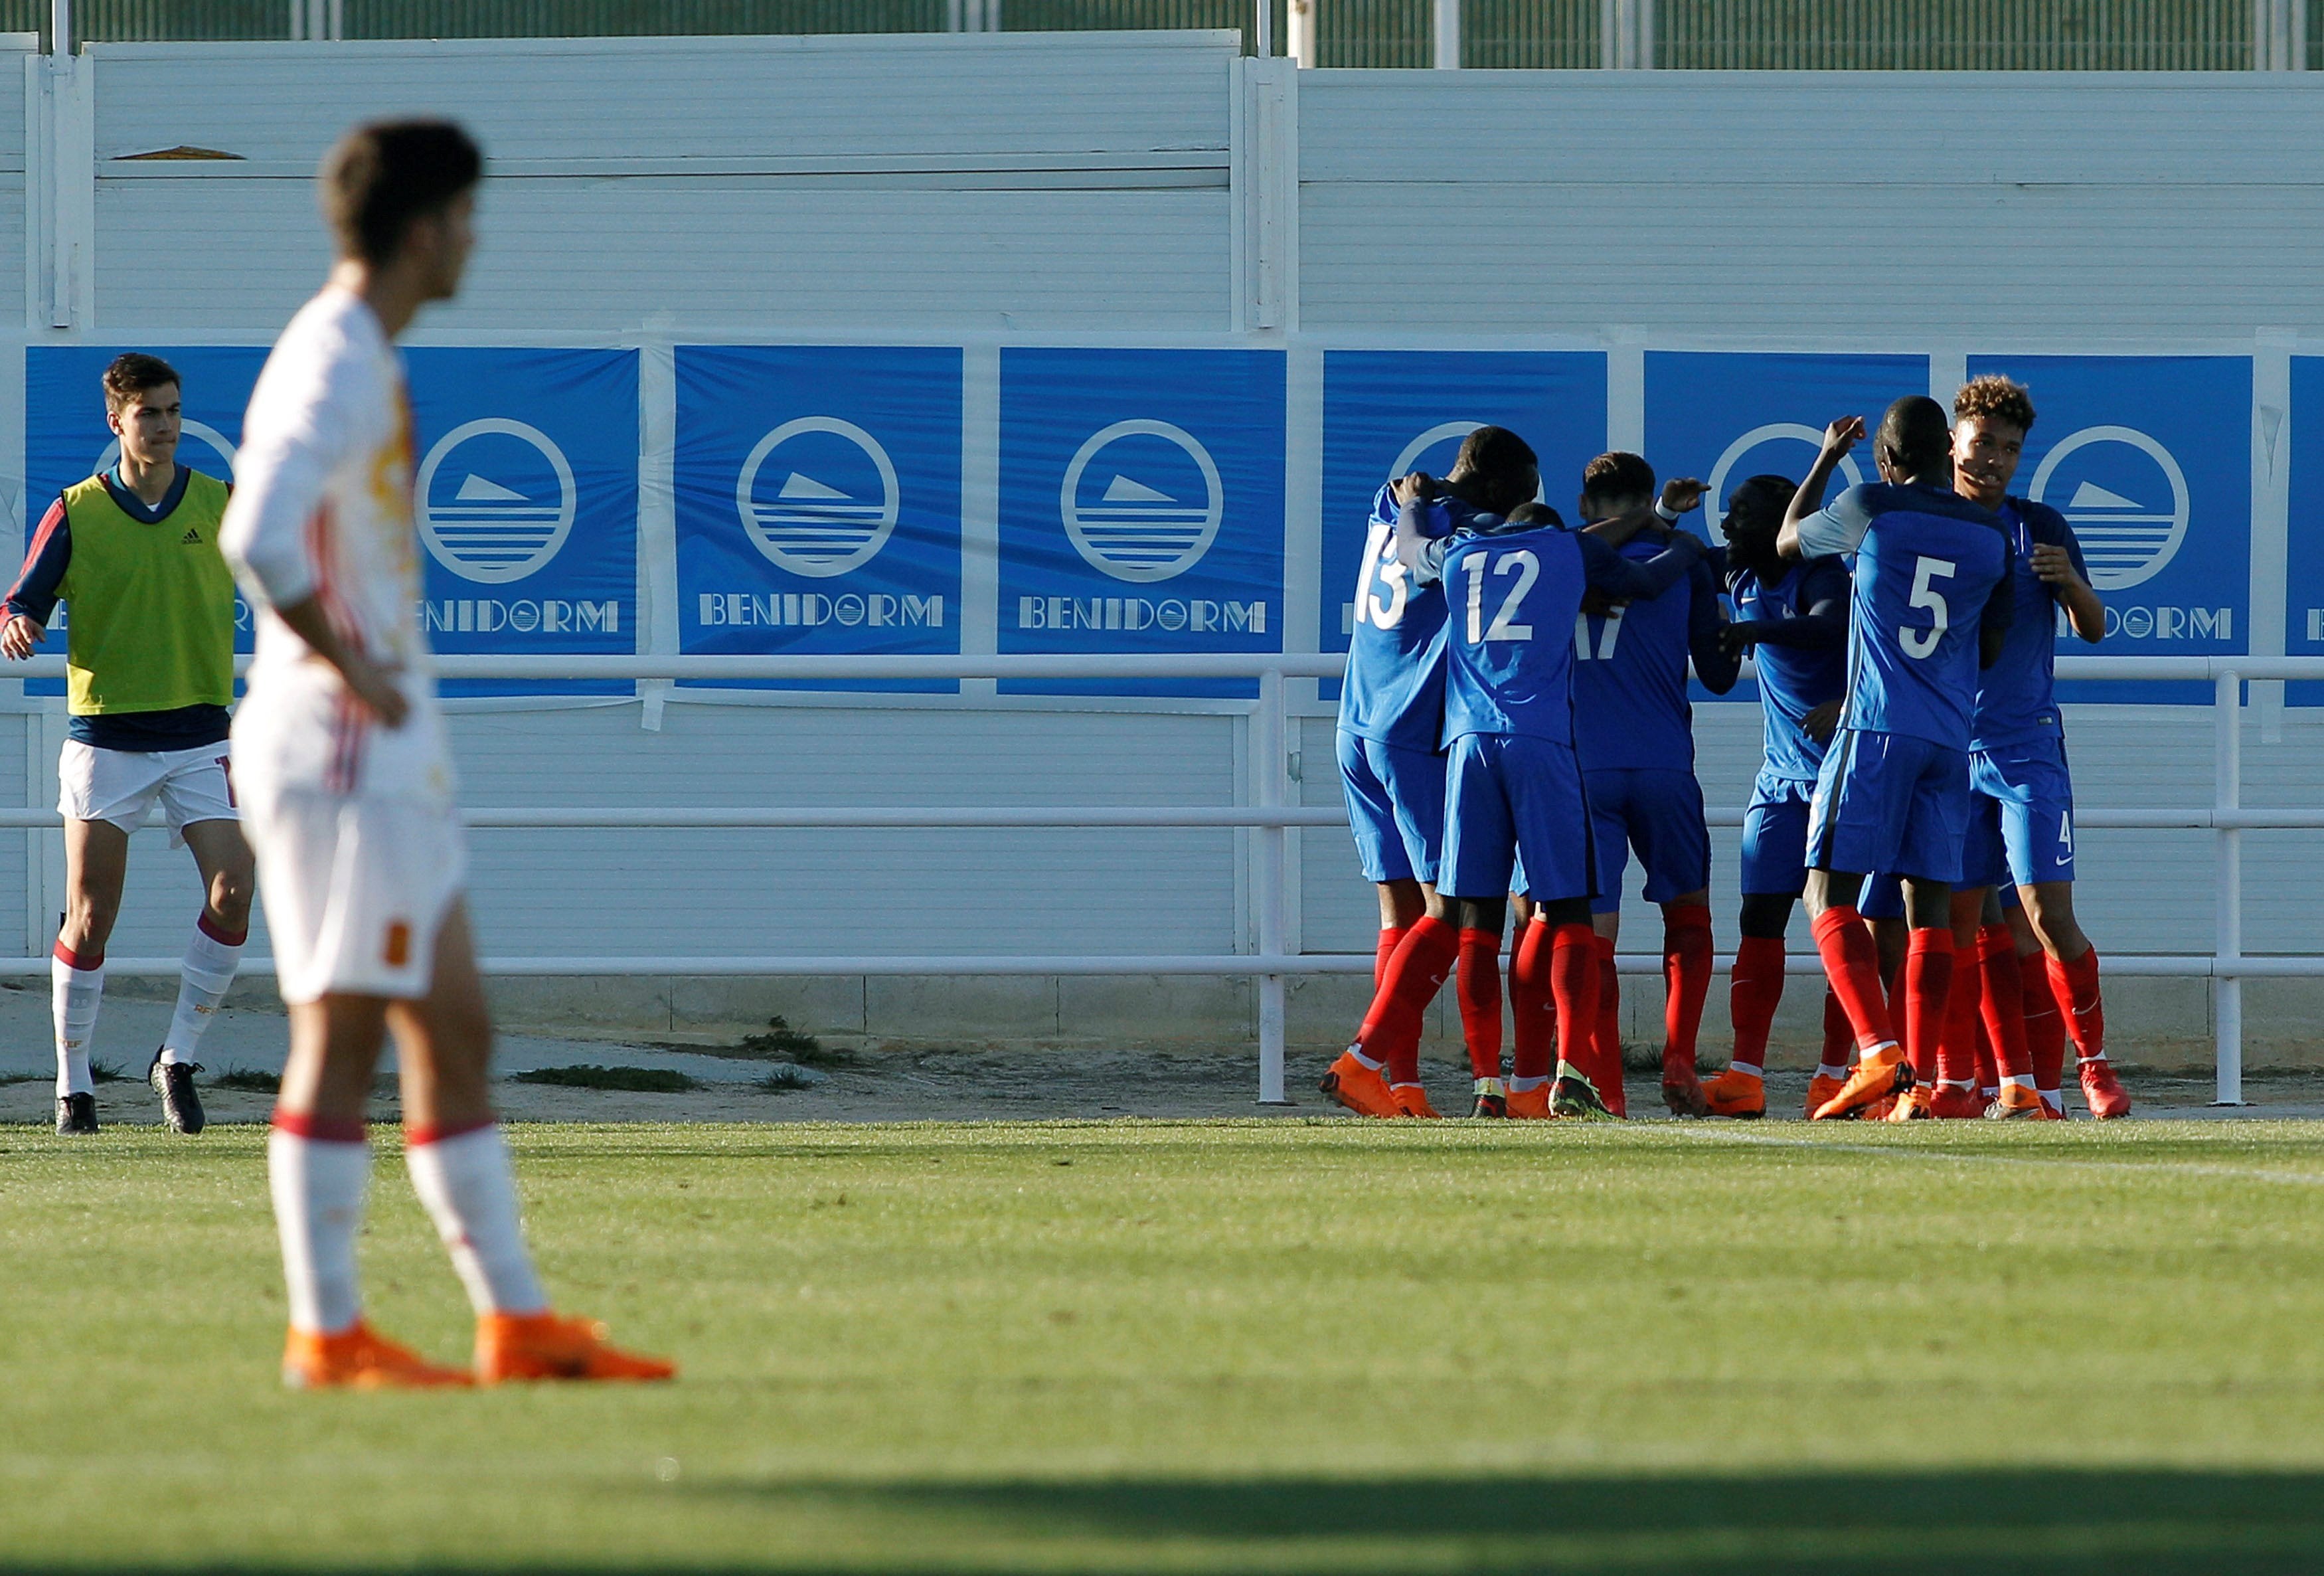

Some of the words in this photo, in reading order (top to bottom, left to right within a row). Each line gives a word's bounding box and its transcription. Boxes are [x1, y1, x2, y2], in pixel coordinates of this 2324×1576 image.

[1356, 524, 1408, 630] 13
[1461, 549, 1540, 644] 12
[415, 599, 618, 632] NIDORM
[699, 593, 943, 627] BENIDORM
[1019, 596, 1266, 633] BENIDORM
[1898, 555, 1956, 659] 5
[2058, 810, 2072, 853] 4
